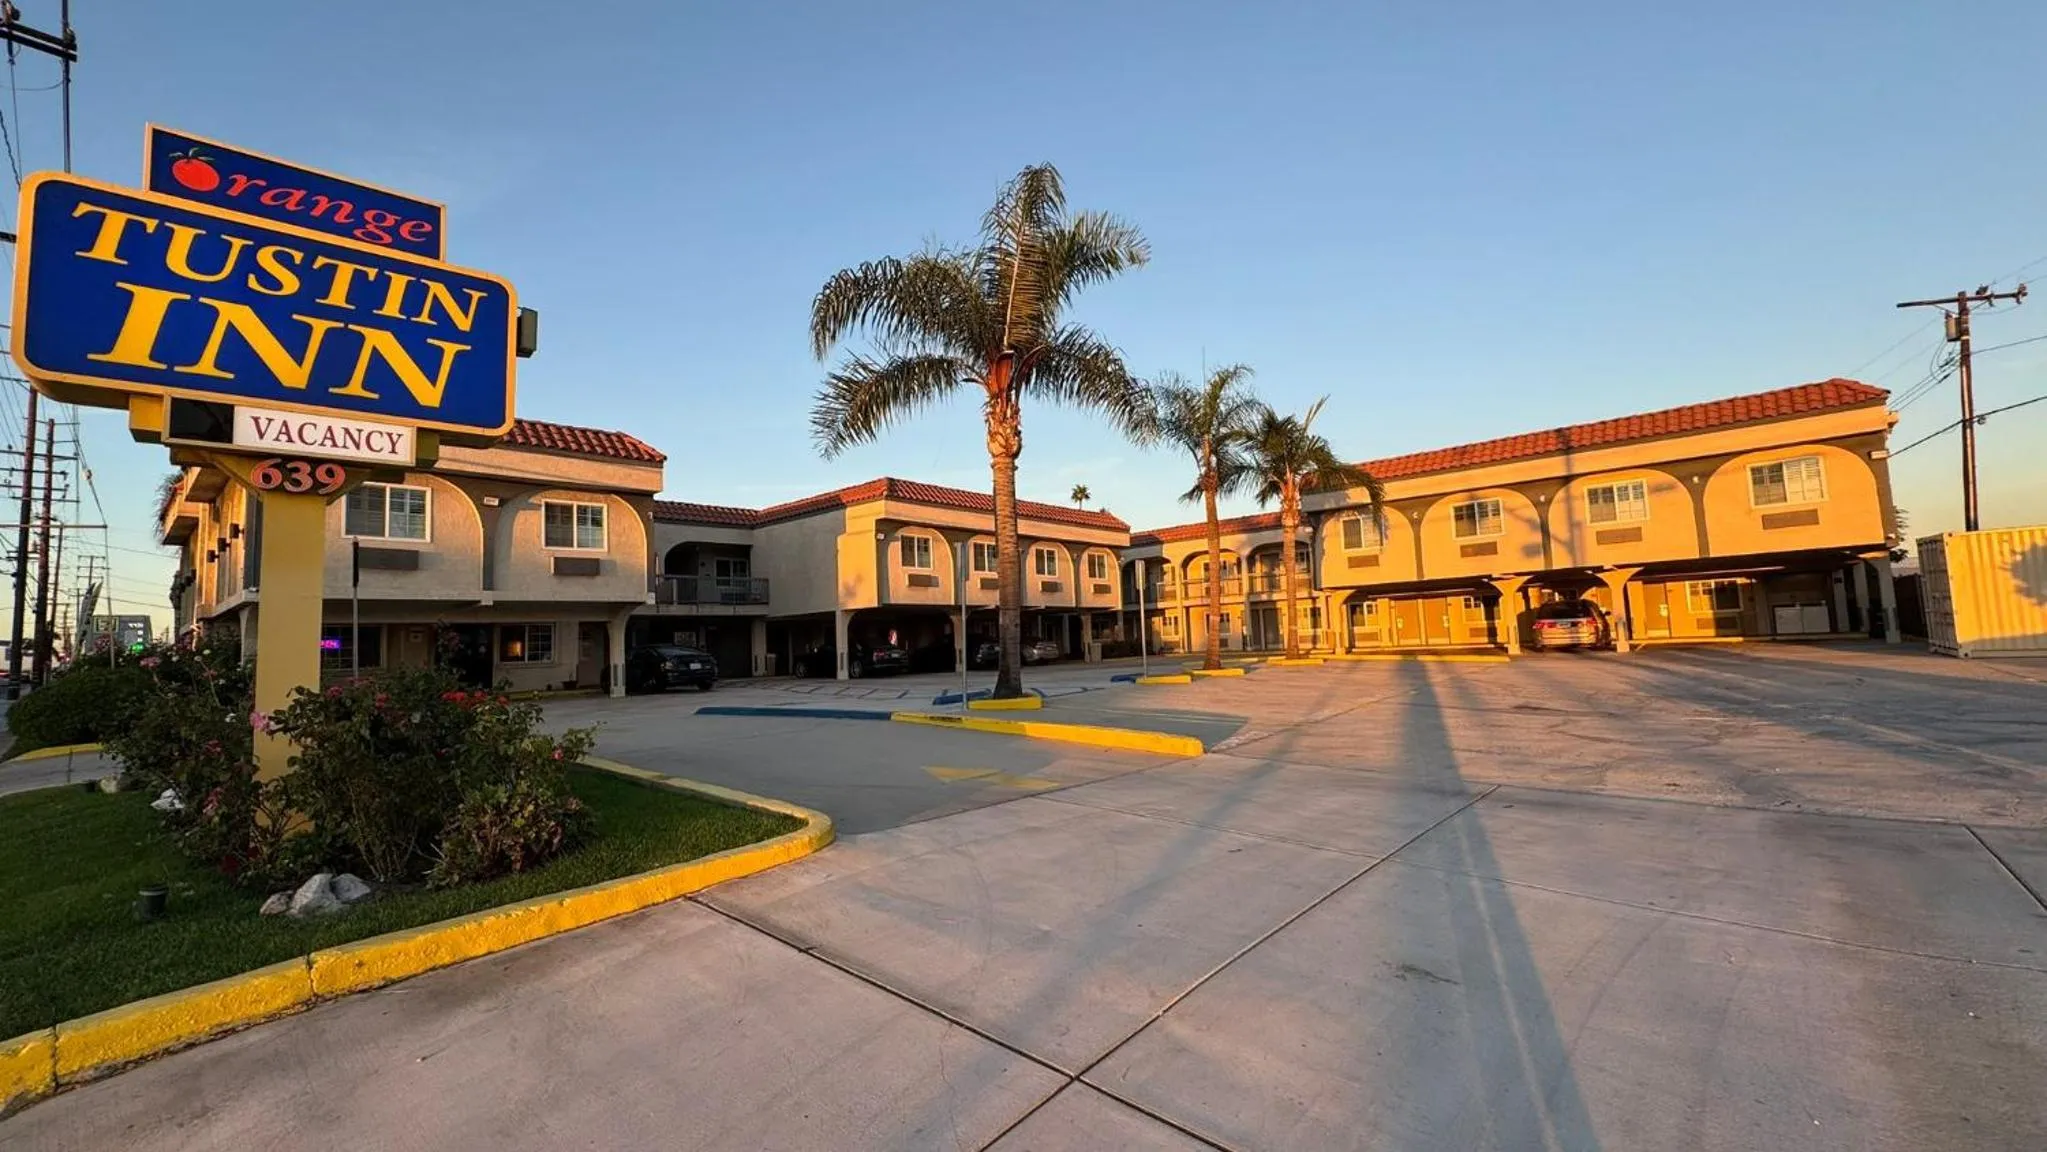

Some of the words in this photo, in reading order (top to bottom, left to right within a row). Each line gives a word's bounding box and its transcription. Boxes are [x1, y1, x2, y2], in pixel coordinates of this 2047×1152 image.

[72, 202, 488, 332] TUSTIN
[87, 281, 472, 408] INN
[250, 415, 404, 454] VACANCY
[250, 457, 347, 496] 639
